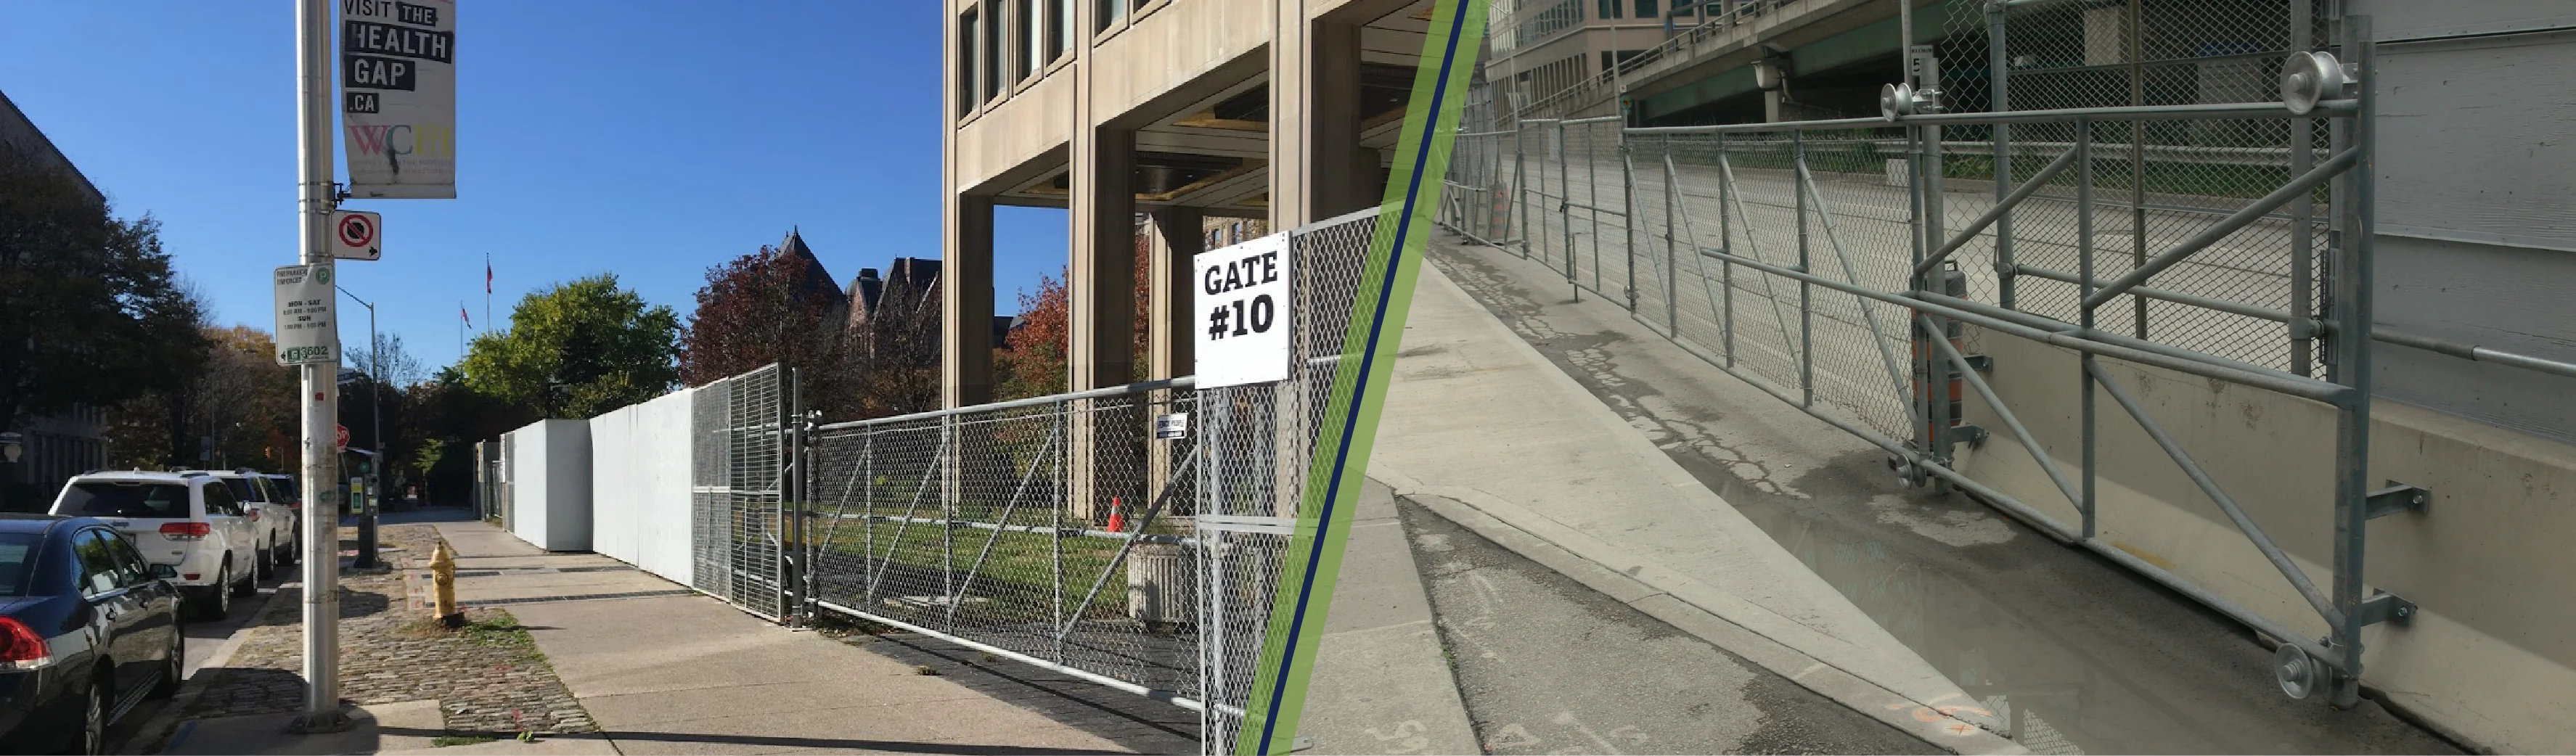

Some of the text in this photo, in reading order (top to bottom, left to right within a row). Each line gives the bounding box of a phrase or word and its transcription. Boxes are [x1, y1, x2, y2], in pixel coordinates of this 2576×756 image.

[344, 0, 434, 25] VISIT THE
[351, 23, 446, 59] HEALTH
[354, 59, 406, 86] GAP
[1913, 58, 1920, 73] 5
[349, 94, 375, 112] .CA
[1204, 250, 1277, 295] GATE
[1209, 294, 1274, 341] #10
[301, 345, 329, 359] 3602
